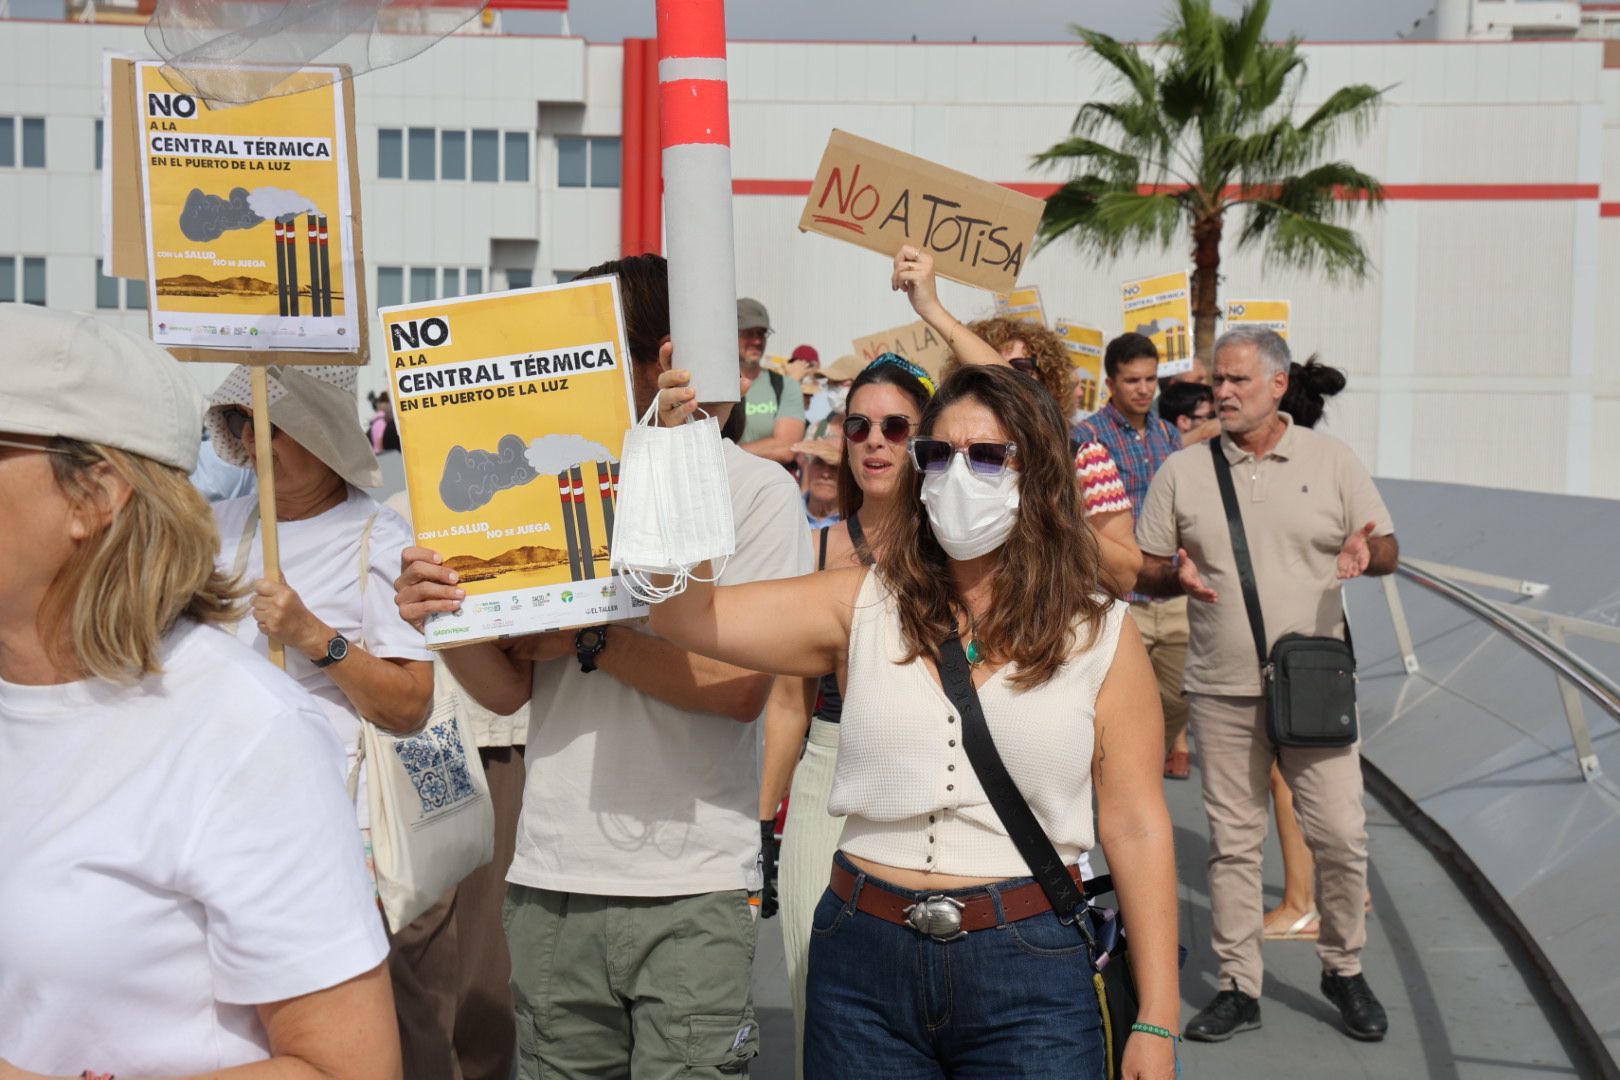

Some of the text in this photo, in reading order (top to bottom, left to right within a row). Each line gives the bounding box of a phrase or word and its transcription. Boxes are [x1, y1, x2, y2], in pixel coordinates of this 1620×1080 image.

[149, 93, 196, 118] NO
[150, 121, 177, 131] A LA
[151, 137, 330, 157] CENTRAL TÉRMICA
[151, 157, 291, 171] EN EL PUERTO DE LA LUZ
[818, 164, 880, 221] NO
[879, 189, 910, 238] A
[184, 250, 216, 260] SALUD
[1123, 285, 1140, 296] NO
[1228, 305, 1245, 316] NO
[390, 317, 449, 352] NO
[912, 326, 939, 352] LA
[395, 354, 428, 368] A LA
[398, 348, 614, 394] CENTRAL TÉRMICA
[400, 378, 569, 412] EN EL PUERTO DE LA LUZ
[418, 522, 489, 540] CON LA SALUD
[486, 529, 503, 539] NO
[516, 522, 551, 536] JUEGA
